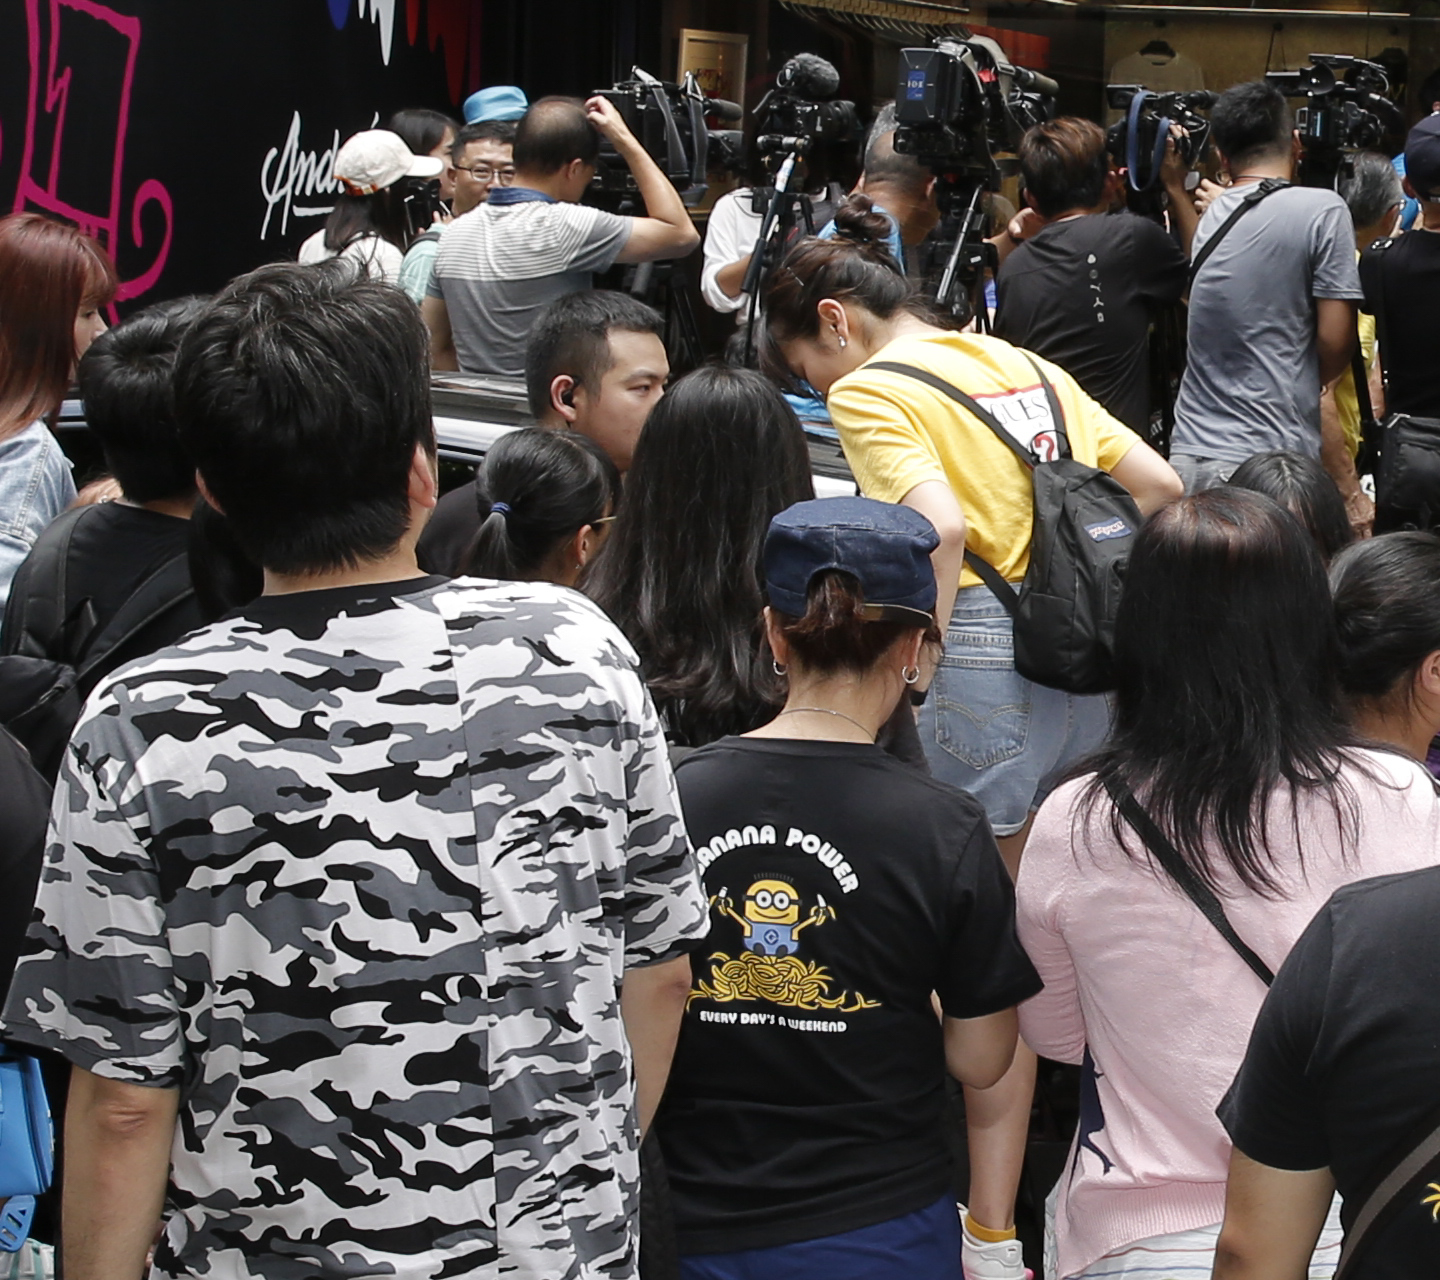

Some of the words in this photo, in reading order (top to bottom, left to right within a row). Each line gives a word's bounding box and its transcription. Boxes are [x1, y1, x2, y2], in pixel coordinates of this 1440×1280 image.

[261, 110, 379, 240] And
[990, 396, 1049, 425] GUES
[785, 827, 860, 894] POWER
[699, 1010, 738, 1024] EVERY
[740, 1013, 775, 1025] DAY'S
[778, 1016, 787, 1026] A
[788, 1019, 848, 1033] WEEKEND
